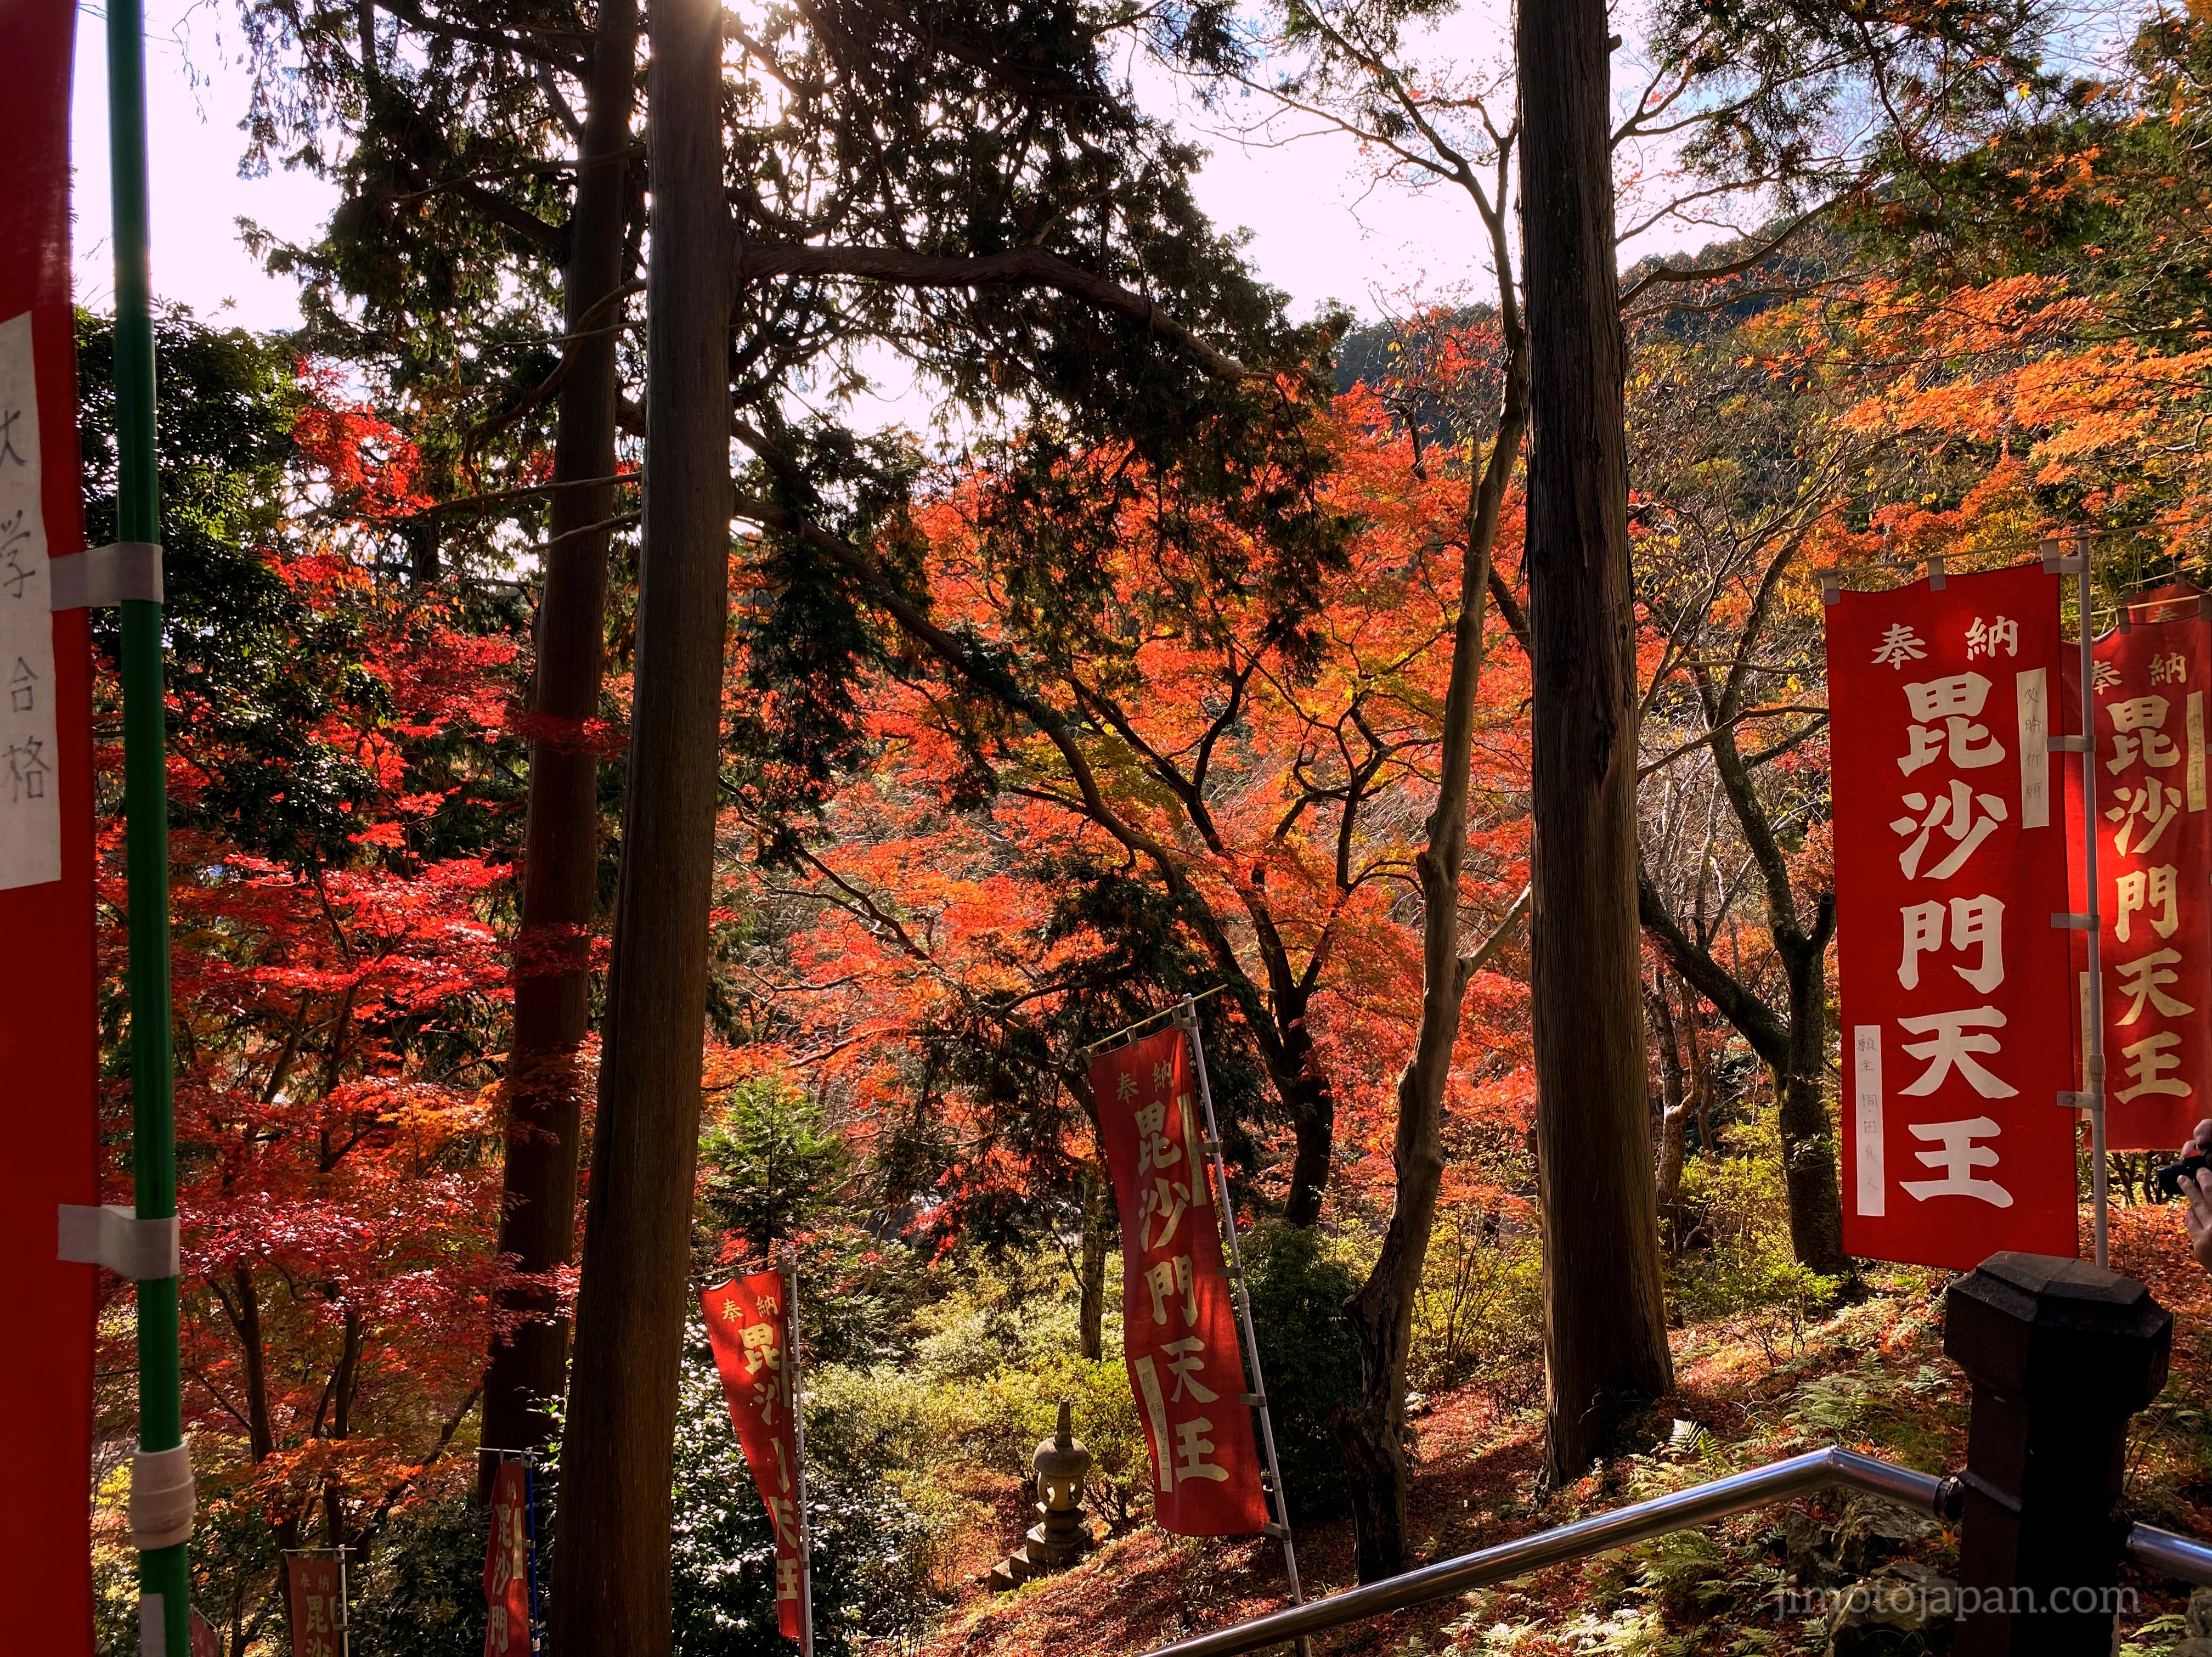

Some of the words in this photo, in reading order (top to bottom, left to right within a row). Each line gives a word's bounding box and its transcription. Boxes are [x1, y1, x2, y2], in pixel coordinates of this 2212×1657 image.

[1871, 616, 2018, 670] 奉納
[2024, 687, 2042, 799] 必勝祈願
[1889, 672, 2019, 1208] 毘沙門天王
[2105, 695, 2194, 1104] 毘沙門天王
[1115, 1060, 1174, 1104] 奉納
[721, 1294, 779, 1323] 奉納
[1134, 1100, 1229, 1483] 毘沙門天王
